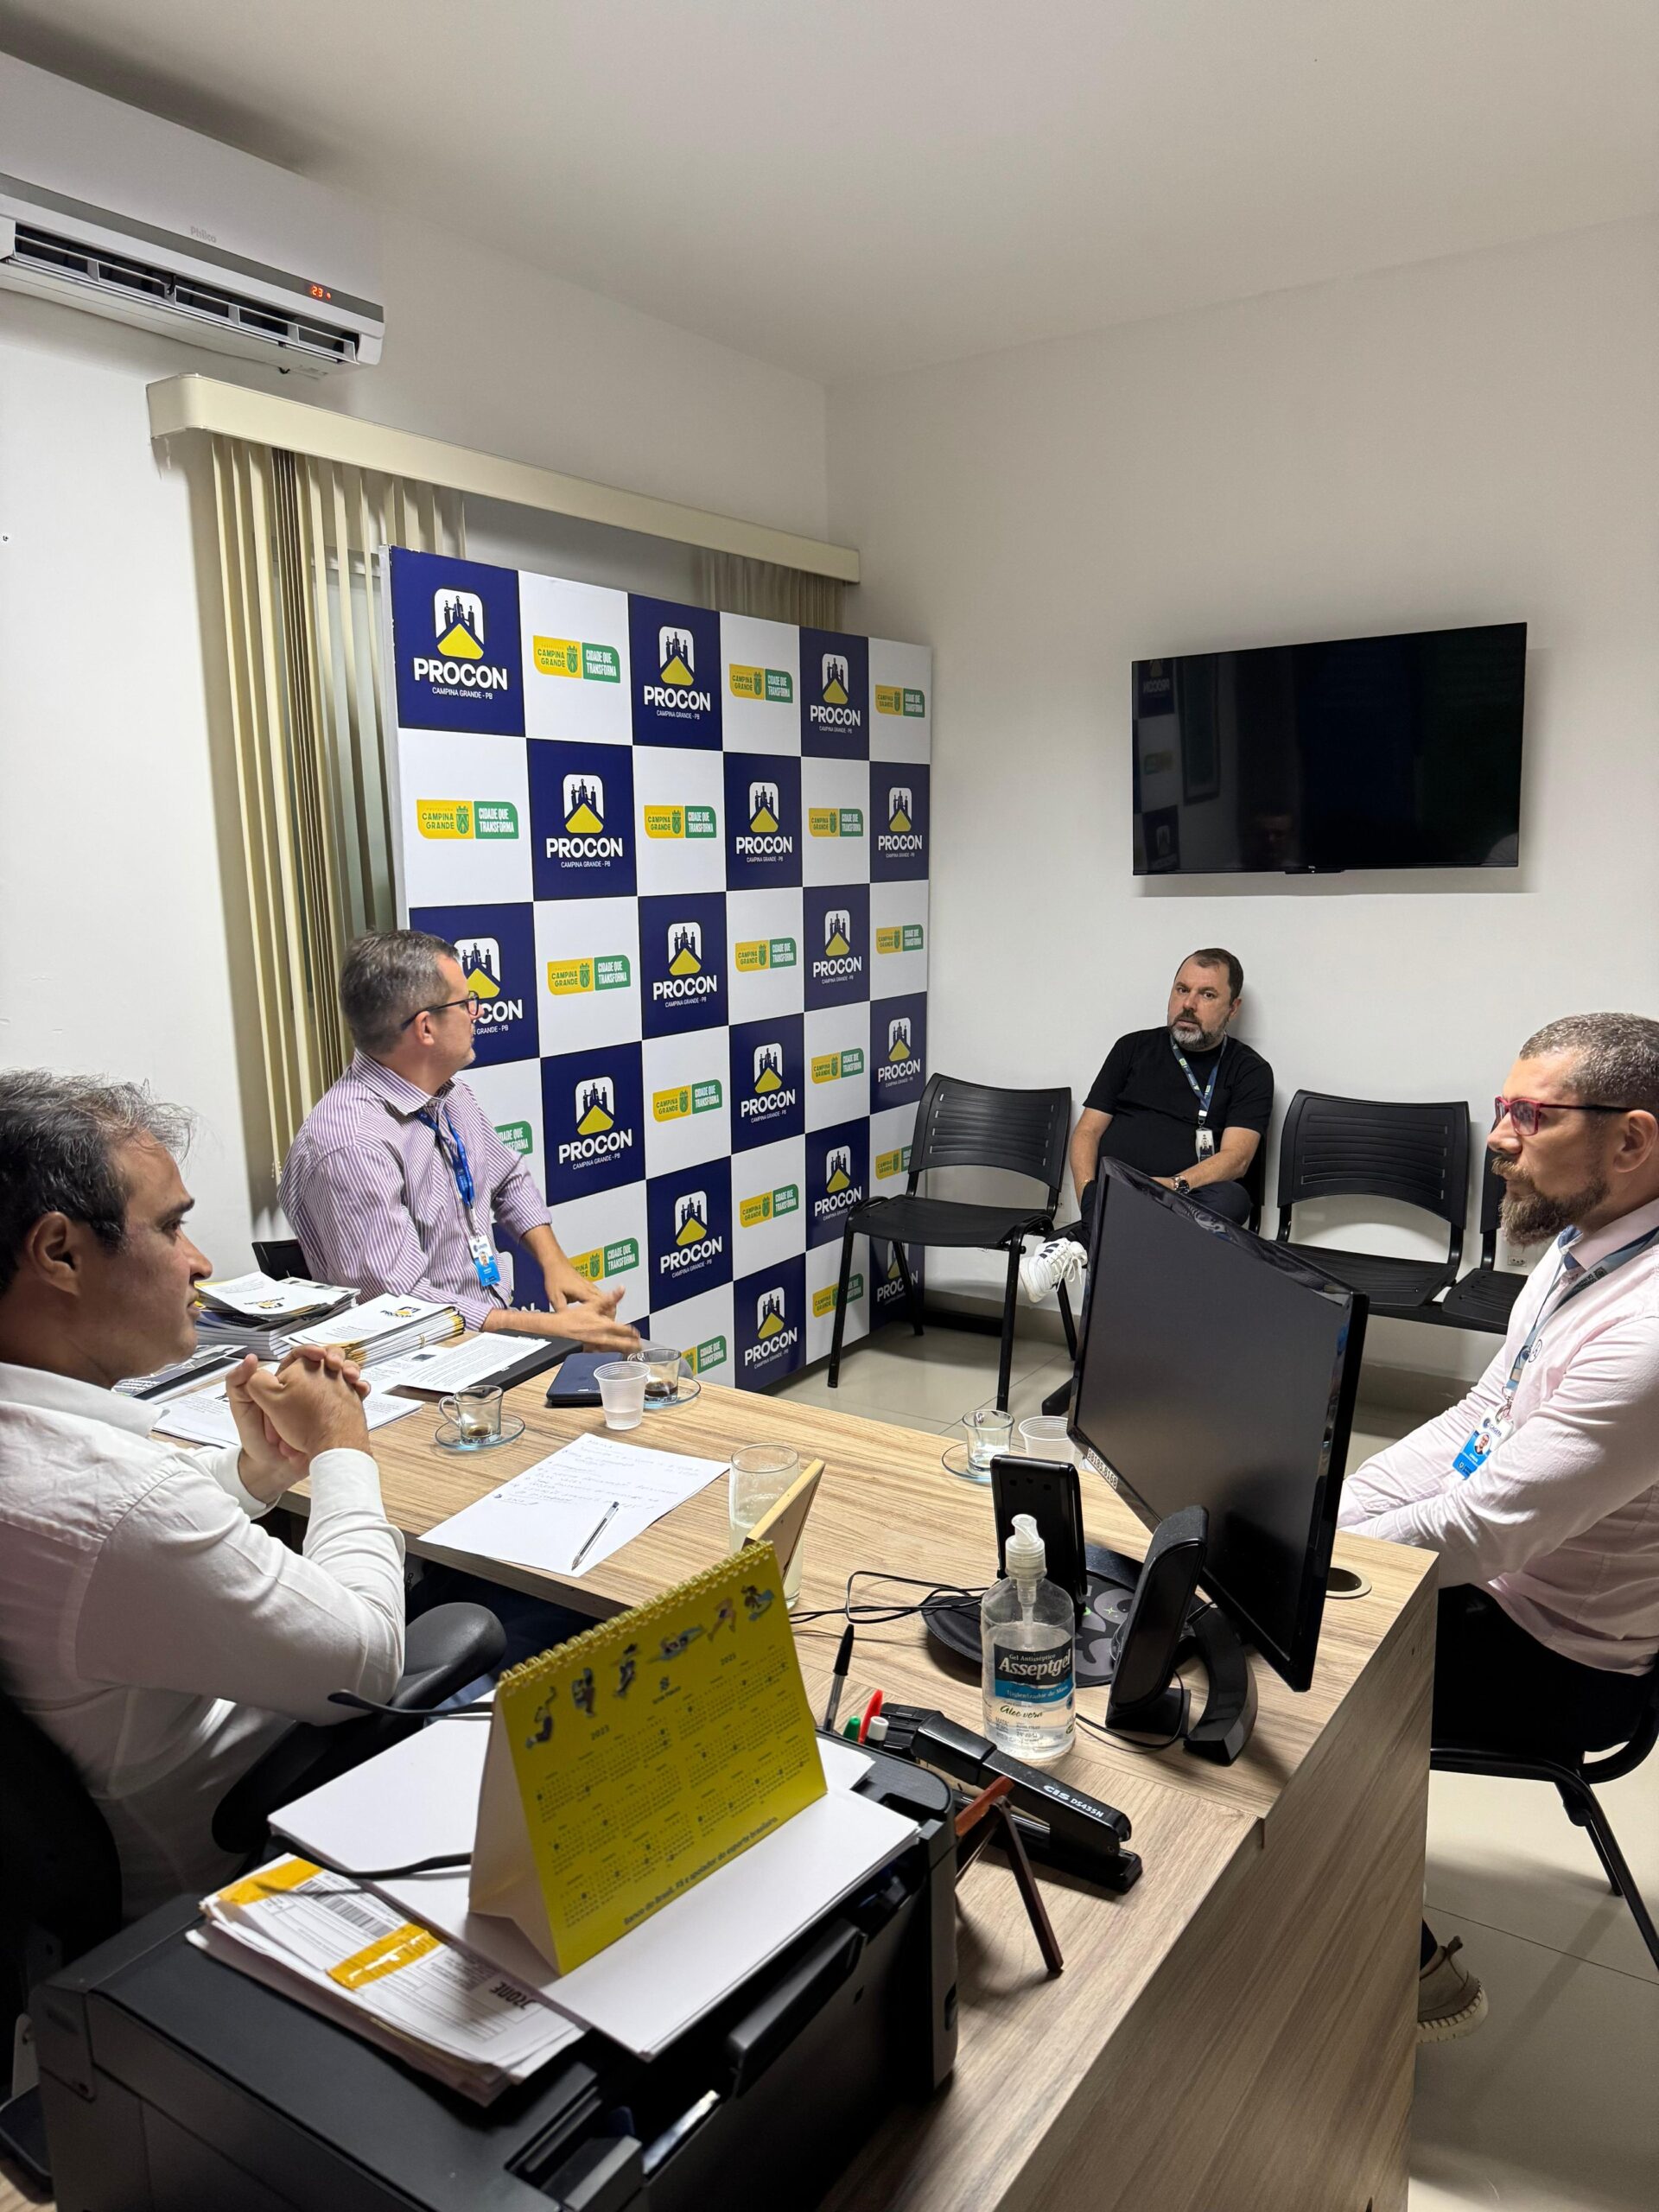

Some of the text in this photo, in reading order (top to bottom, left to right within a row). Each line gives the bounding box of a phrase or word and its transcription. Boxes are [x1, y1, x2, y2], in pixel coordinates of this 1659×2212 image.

[312, 285, 323, 298] 23
[537, 647, 564, 658] CAMPINA
[540, 657, 565, 667] GRANDE
[586, 649, 612, 664] CIDADE QUE
[413, 657, 507, 690] PROCON
[643, 684, 710, 711] PROCON
[810, 704, 860, 726] PROCON
[478, 808, 509, 819] CIDADE QUE
[545, 837, 622, 858] PROCON
[735, 836, 792, 854] PROCON
[878, 835, 921, 850] PROCON
[551, 969, 577, 980] CAMPINA
[597, 960, 623, 973] CIDADE QUE
[813, 956, 861, 978] PROCON
[554, 978, 577, 987] GRANDE
[652, 974, 717, 1001] PROCON
[478, 999, 523, 1024] CON
[878, 1058, 920, 1083] PROCON
[656, 1096, 677, 1108] CAMPINA
[658, 1104, 677, 1115] GRANDE
[741, 1088, 795, 1117] PROCON
[558, 1128, 632, 1165] PROCON
[814, 1185, 861, 1217] PROCON
[607, 1243, 631, 1261] CIDADE QUE
[660, 1235, 721, 1274] PROCON
[877, 1270, 918, 1302] PROCN
[744, 1326, 797, 1366] PROCON
[999, 1649, 1071, 1680] Asseptgel
